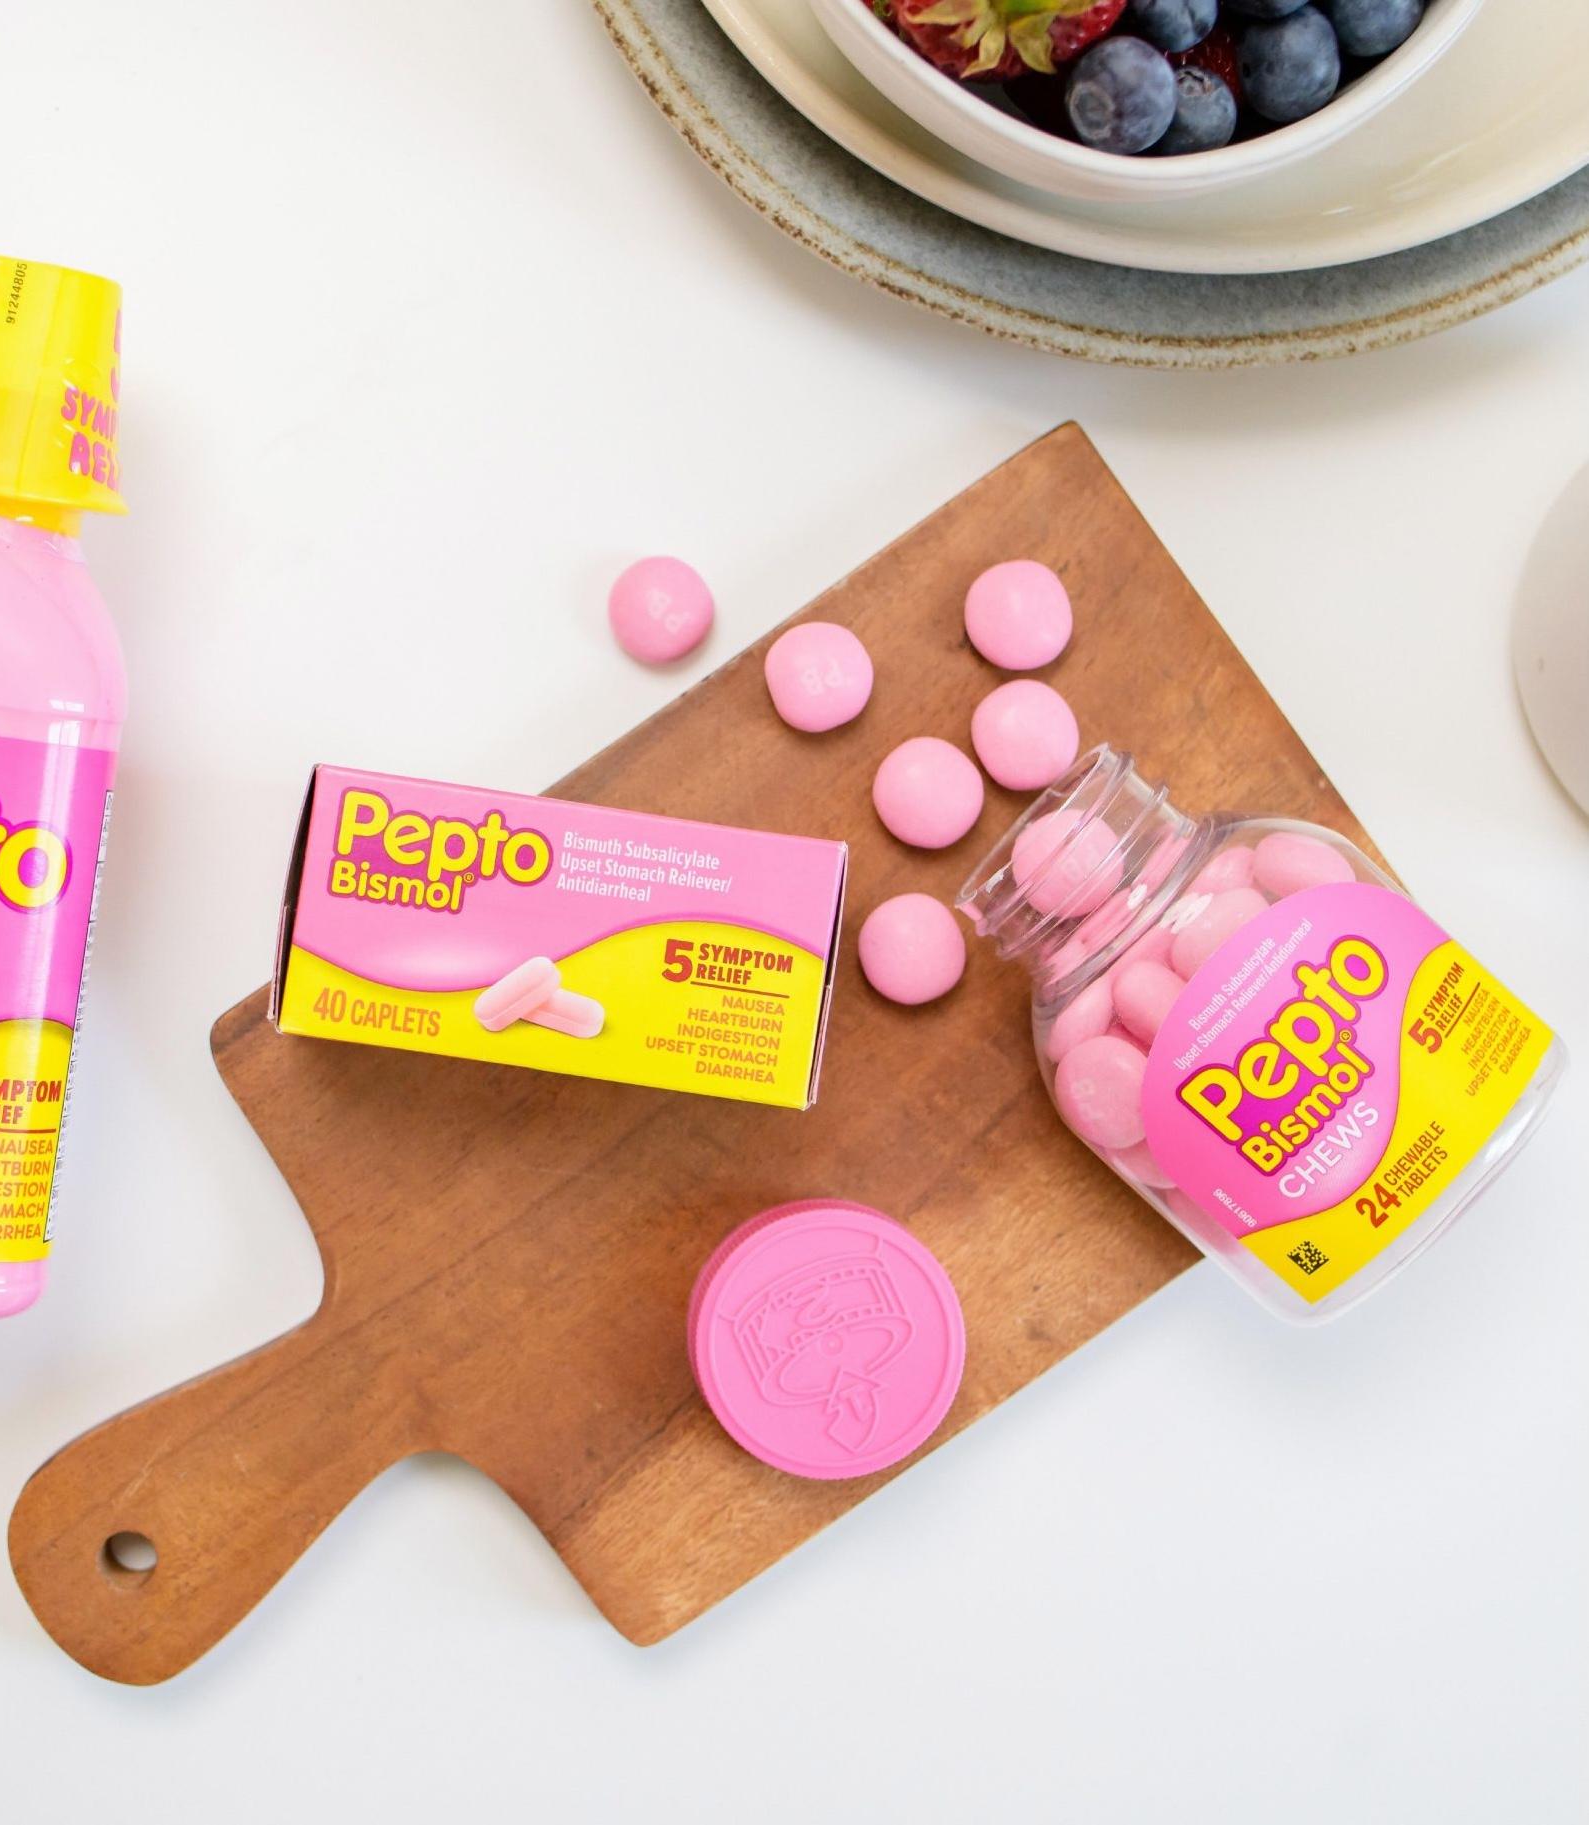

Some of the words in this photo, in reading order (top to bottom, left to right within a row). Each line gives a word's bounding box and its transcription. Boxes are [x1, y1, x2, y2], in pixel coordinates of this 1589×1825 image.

[6, 263, 28, 324] 91244805
[336, 789, 551, 884] Pepto
[563, 831, 622, 857] Bismuth
[624, 840, 721, 870] Subsalicylate
[556, 874, 652, 902] Antidiarrheal
[560, 852, 602, 874] Upset
[604, 858, 665, 884] Stomach
[668, 868, 733, 893] Reliever/
[661, 938, 695, 983] 5
[695, 963, 753, 986] RELIEF
[698, 943, 794, 974] SYMPTOM
[722, 995, 786, 1016] NAUSEA
[1188, 993, 1228, 1031] Bismuth
[1221, 937, 1277, 996] Subsalicylate
[1423, 961, 1465, 1021] SYMPTOM
[1463, 988, 1491, 1027] NAUSEA
[312, 987, 348, 1023] 40
[350, 999, 442, 1037] CAPLETS
[687, 1007, 783, 1033] HEARTBURN
[1435, 993, 1463, 1031] RELIEF
[1461, 996, 1501, 1055] HEARTBURN
[645, 1035, 696, 1055] UPSET
[698, 1043, 778, 1067] STOMACH
[677, 1023, 781, 1051] INDIGESTION
[1173, 1044, 1203, 1071] Upset
[1196, 1008, 1237, 1048] Stomach
[1180, 938, 1386, 1142] Pepto
[1407, 1018, 1443, 1055] 5
[1465, 1062, 1493, 1097] UPSET
[1489, 1015, 1522, 1065] STOMACH
[1467, 1006, 1511, 1071] INDIGESTION
[1499, 1026, 1532, 1075] DIARRHEA
[695, 1060, 776, 1084] DIARRHEA
[1278, 1100, 1379, 1199] CHEWS
[1383, 1120, 1446, 1187] CHEWABLE
[1395, 1145, 1449, 1198] TABLETS
[1355, 1182, 1403, 1229] 24
